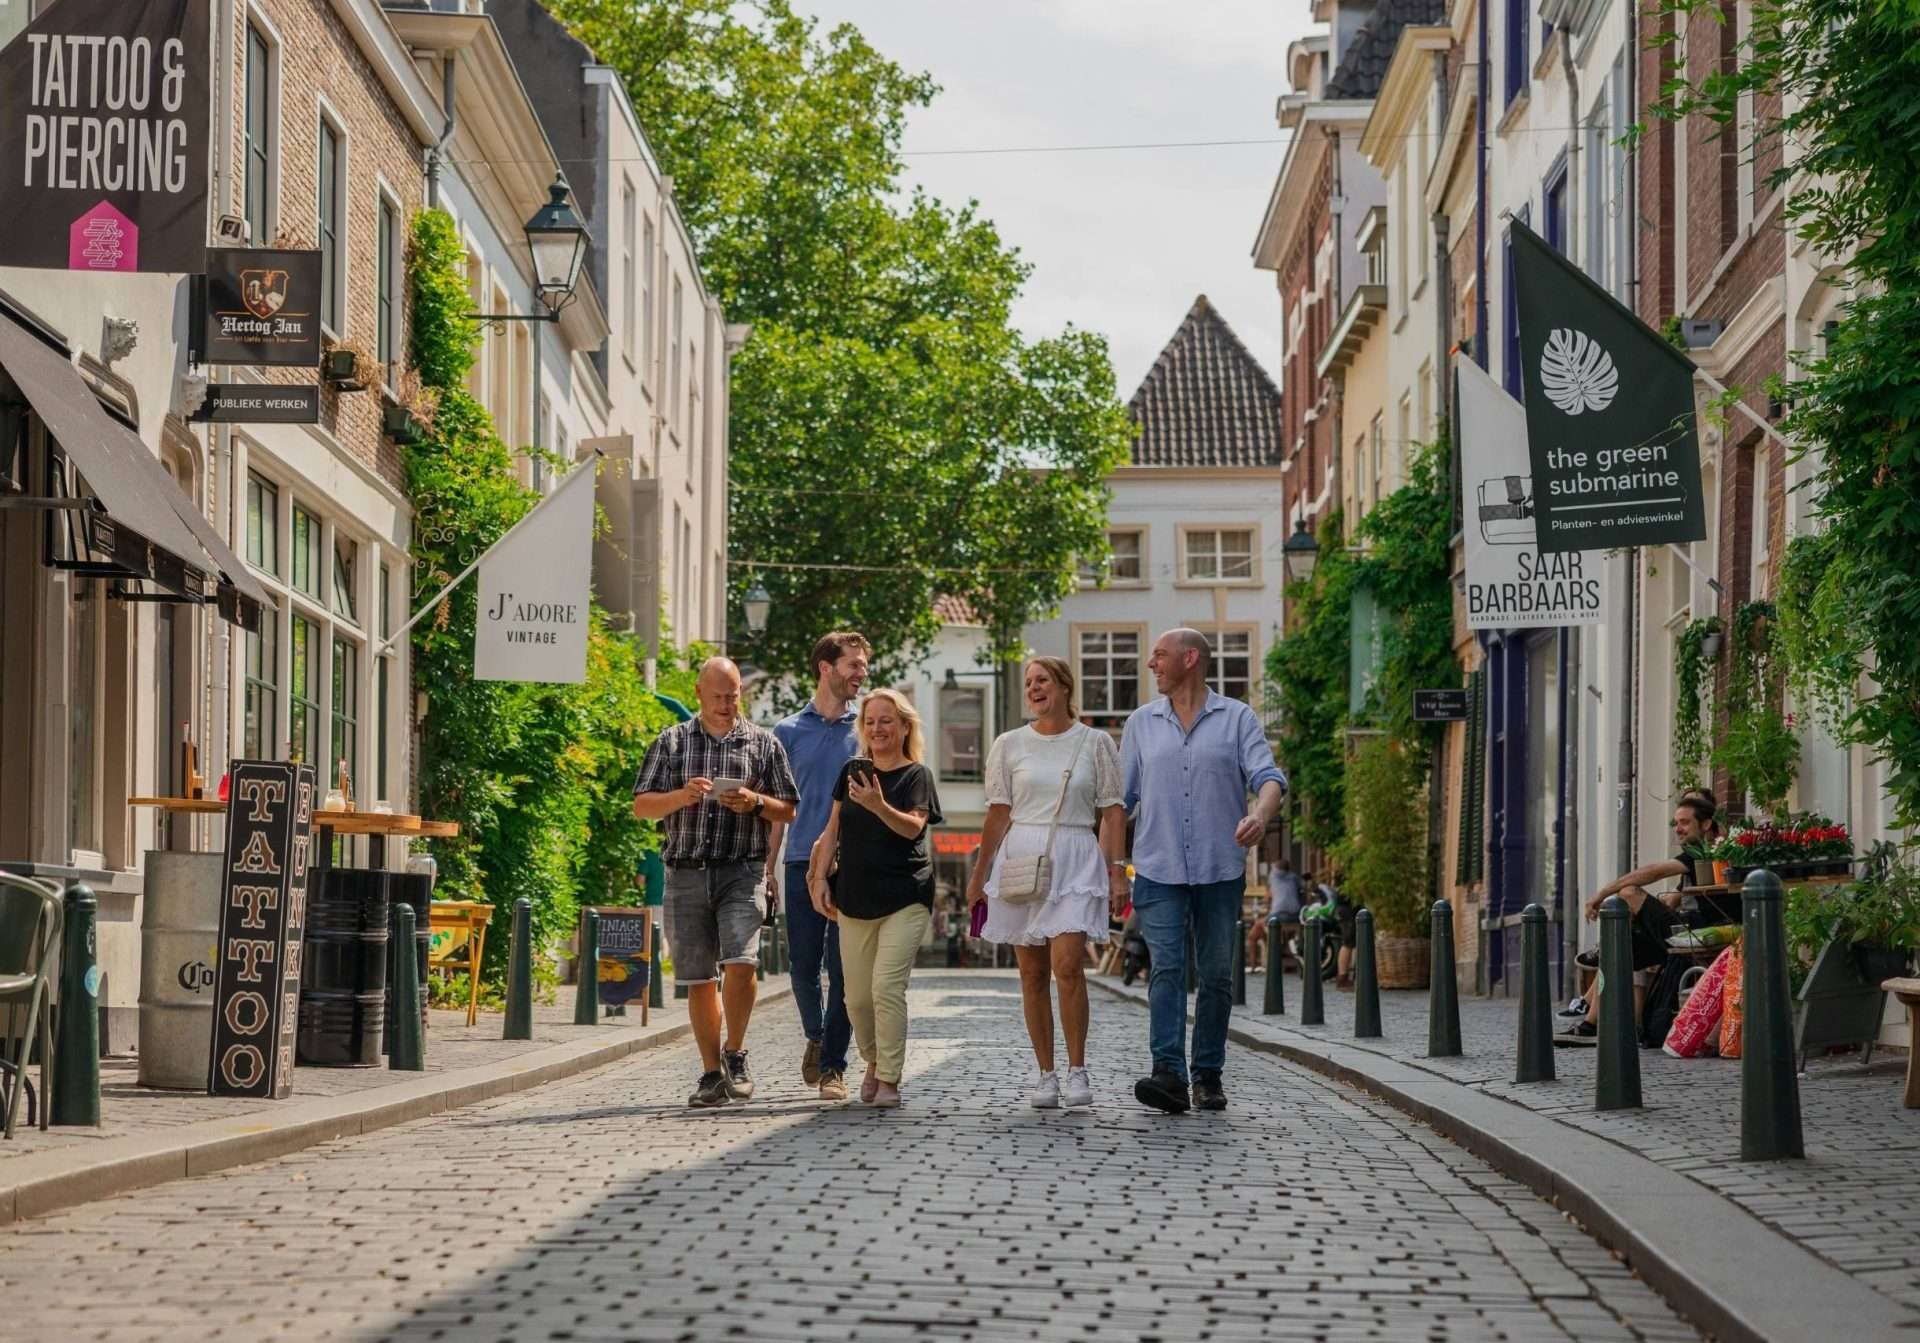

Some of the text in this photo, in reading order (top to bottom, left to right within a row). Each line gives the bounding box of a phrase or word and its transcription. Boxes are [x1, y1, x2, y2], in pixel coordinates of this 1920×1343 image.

[27, 33, 186, 112] TATTOO &
[24, 114, 187, 193] PIERCING
[221, 316, 302, 337] Hertog Jan
[213, 399, 308, 409] PUBLIEKE WERKEN
[1547, 445, 1668, 472] the green
[1550, 467, 1680, 496] submarine
[1551, 510, 1683, 530] Planten- en advieswinkel
[1518, 551, 1583, 582] SAAR
[1469, 580, 1600, 614] BARBAARS
[507, 631, 558, 644] VINTAGE
[220, 778, 286, 1089] TATTOO
[599, 919, 641, 933] INTAGE
[178, 960, 214, 994] Co
